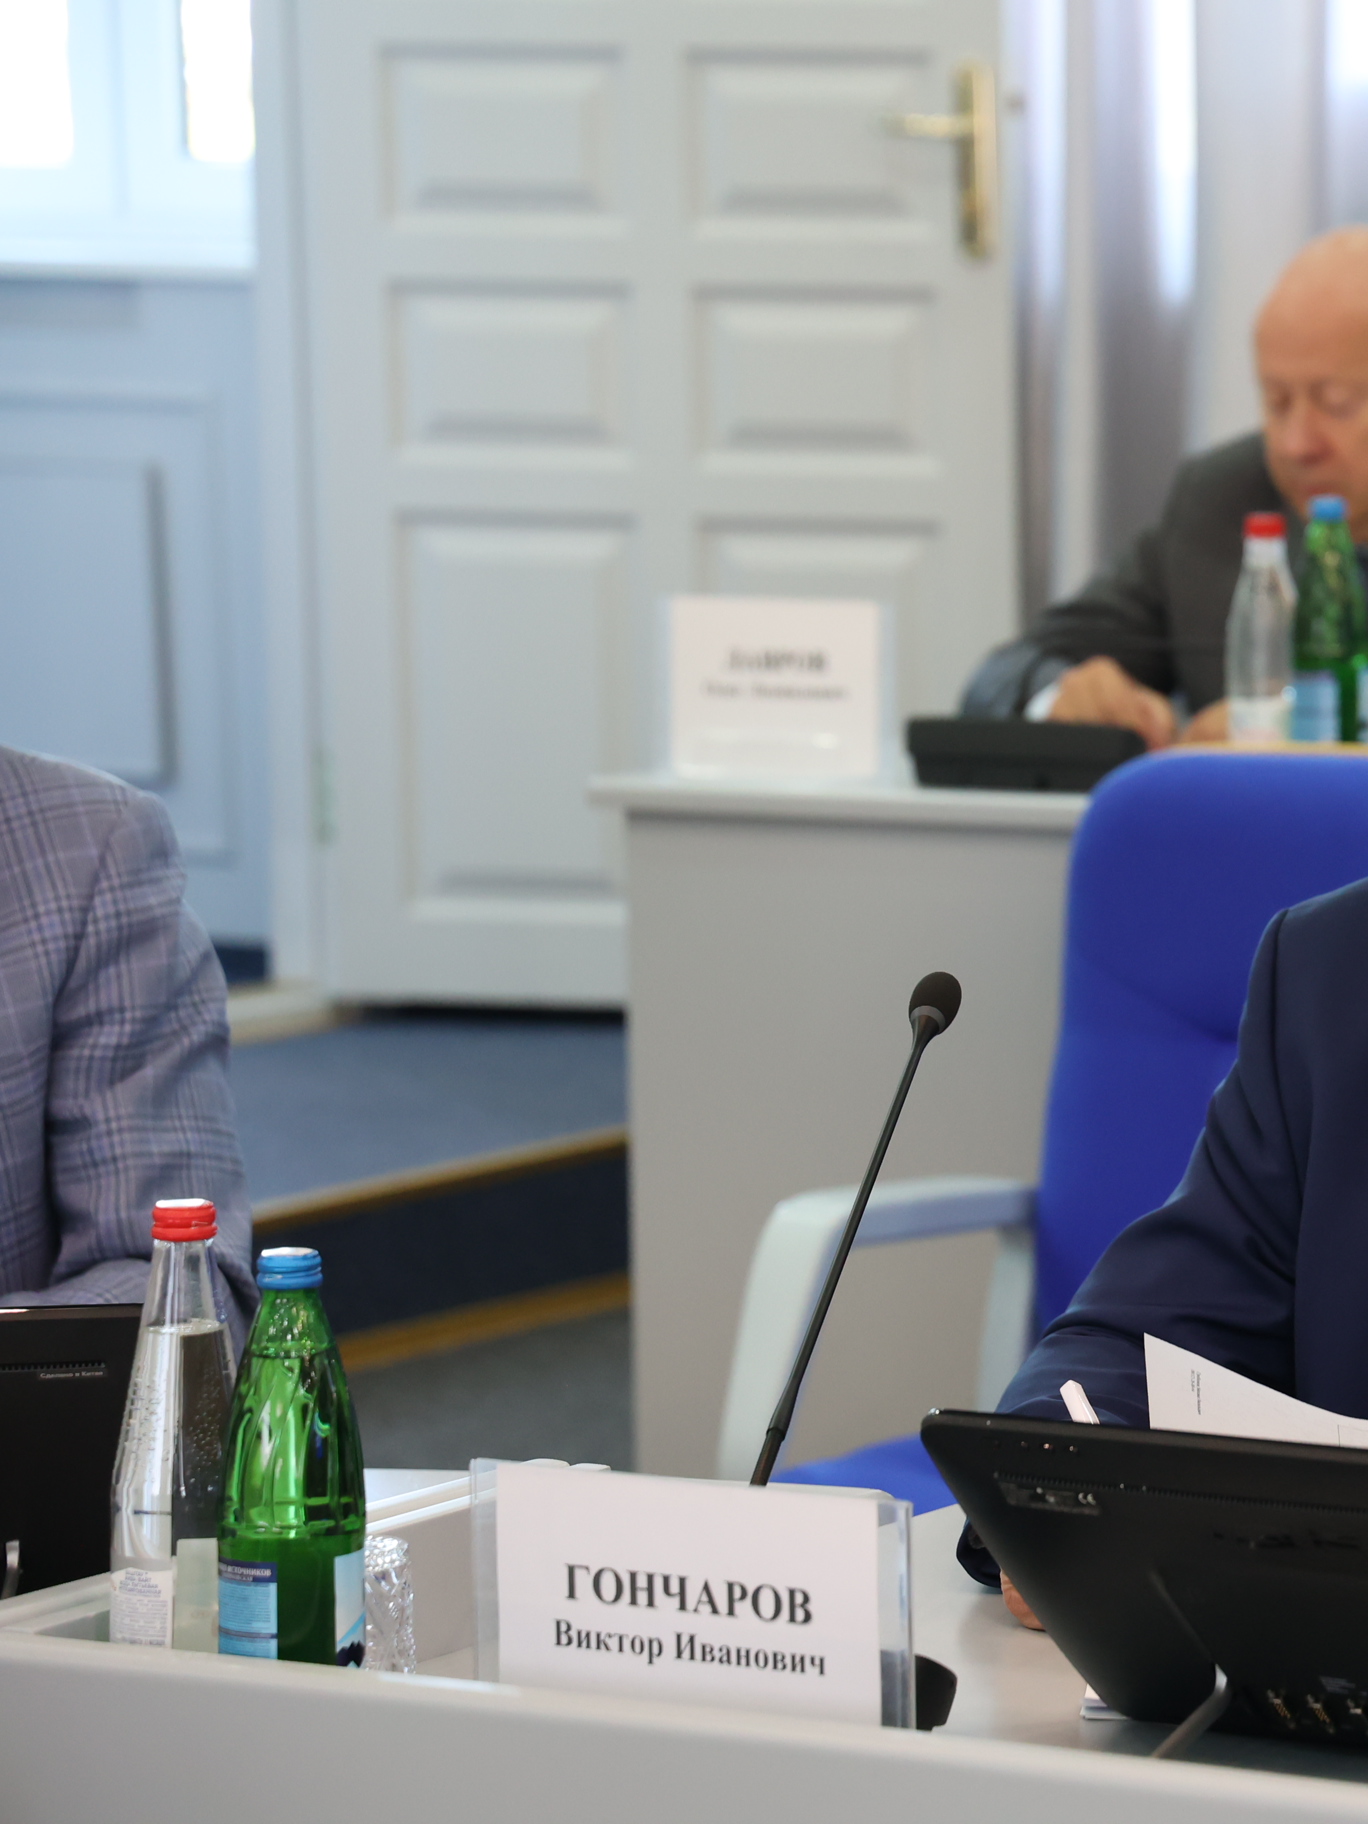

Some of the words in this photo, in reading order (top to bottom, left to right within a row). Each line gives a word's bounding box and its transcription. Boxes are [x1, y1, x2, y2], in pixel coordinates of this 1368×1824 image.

[565, 1563, 812, 1626] ГОНЧАРОВ
[554, 1618, 664, 1666] Виктор
[674, 1631, 826, 1677] Иванович
